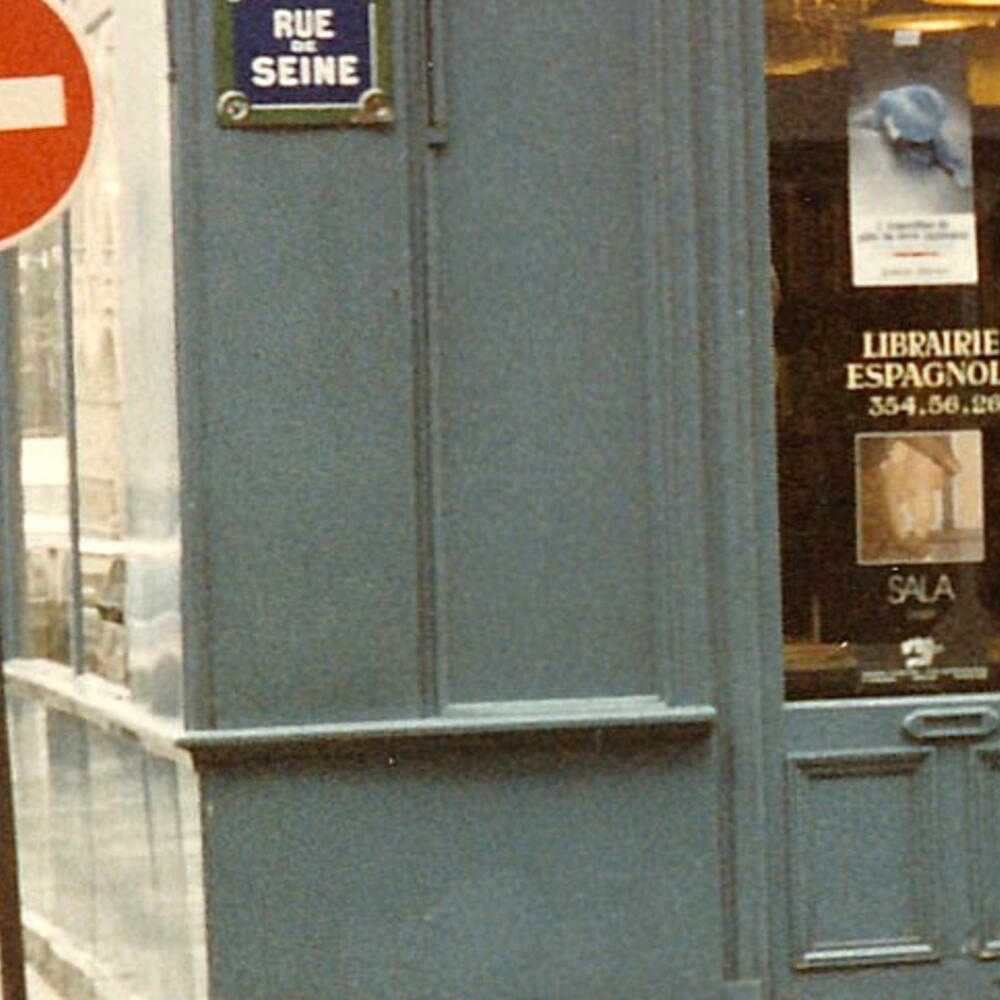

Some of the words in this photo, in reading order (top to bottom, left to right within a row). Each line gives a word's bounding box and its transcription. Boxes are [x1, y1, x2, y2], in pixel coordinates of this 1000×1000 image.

[273, 8, 336, 39] RUE
[251, 55, 361, 87] SEINE
[862, 329, 1000, 358] LIBRAIRIE
[887, 573, 957, 605] SALA
